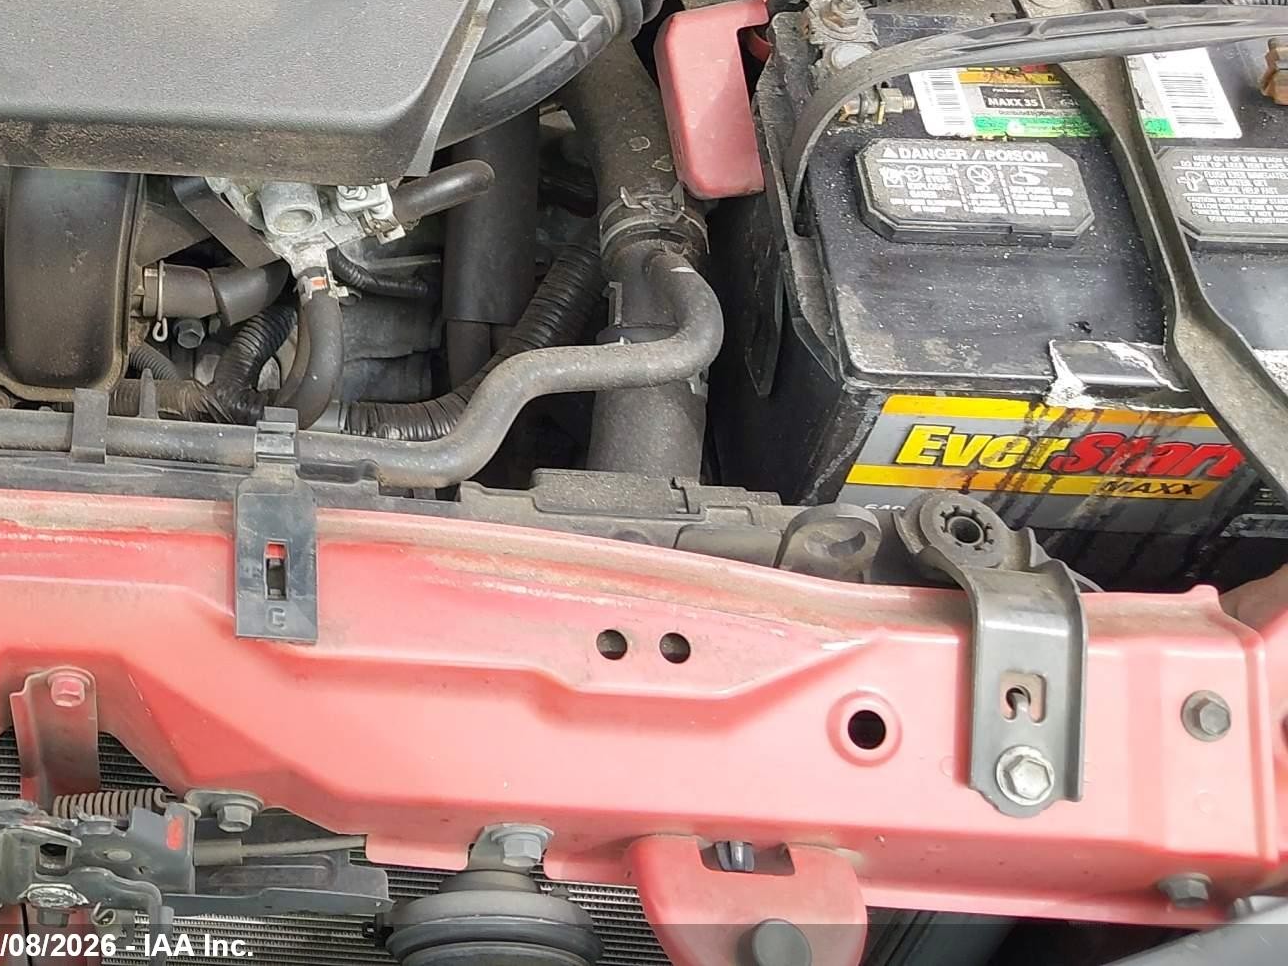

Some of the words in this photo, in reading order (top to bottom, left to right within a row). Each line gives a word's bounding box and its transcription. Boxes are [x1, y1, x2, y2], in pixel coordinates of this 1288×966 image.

[988, 98, 1023, 107] MAXX
[1023, 99, 1039, 107] 35
[897, 147, 969, 161] DANGER
[984, 150, 1049, 163] POISON
[1104, 480, 1202, 495] MAXX
